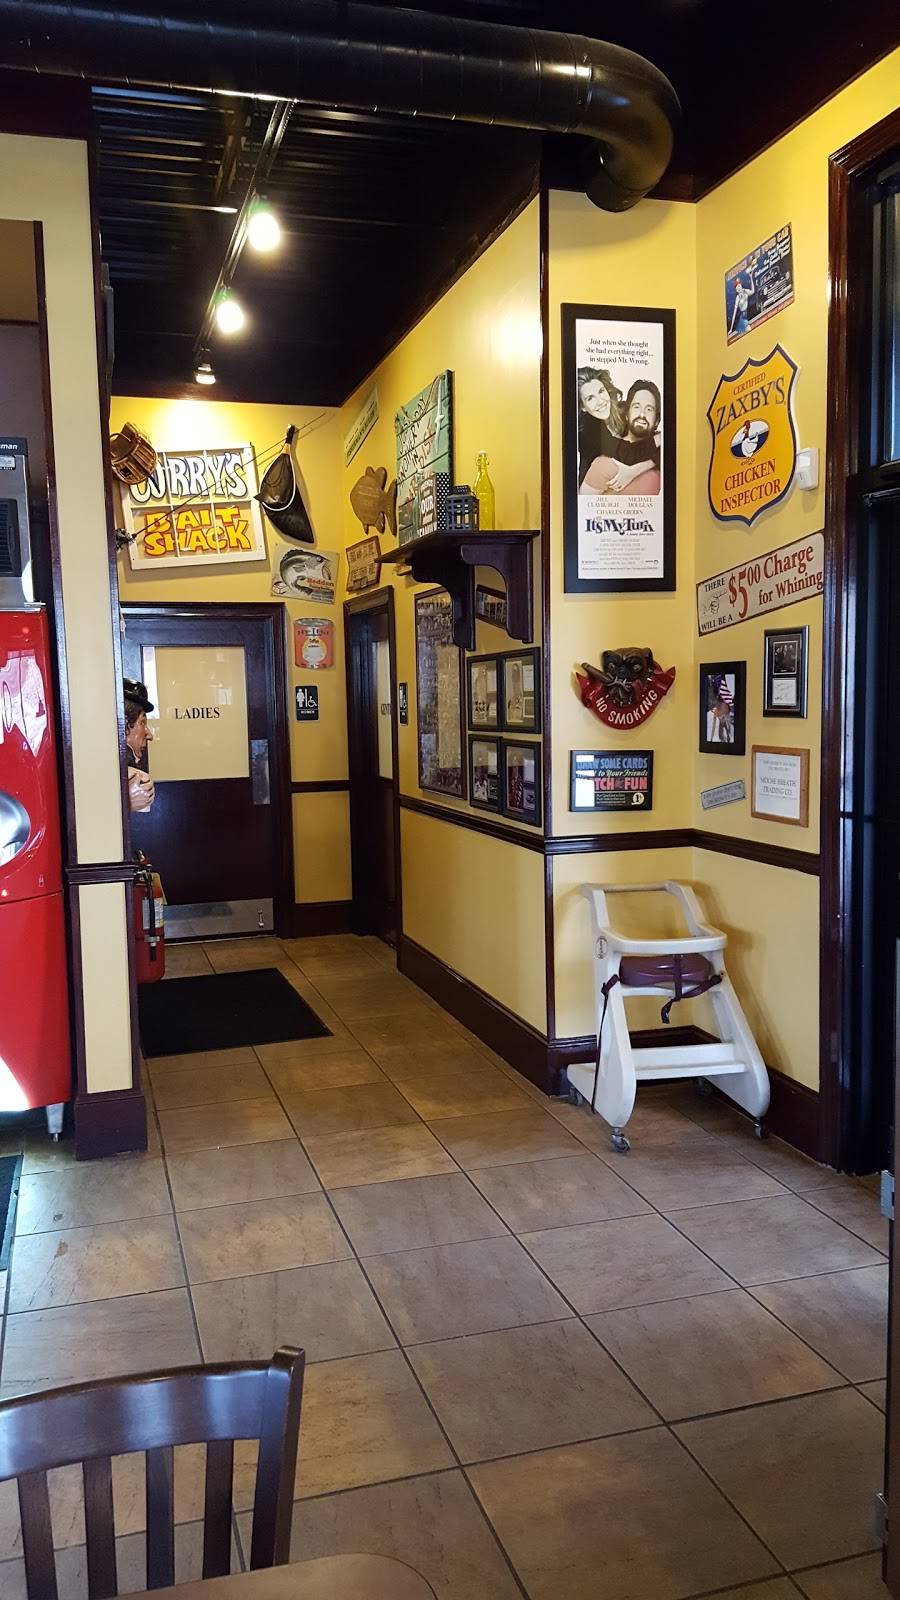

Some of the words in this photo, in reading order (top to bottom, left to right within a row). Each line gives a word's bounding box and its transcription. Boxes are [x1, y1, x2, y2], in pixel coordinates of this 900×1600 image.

[596, 357, 617, 365] stepped
[629, 358, 650, 366] Wrong.
[607, 349, 636, 357] everything
[733, 372, 766, 397] CERTIFIED
[716, 375, 786, 437] ZAXBY'S
[724, 458, 776, 492] CHICKEN
[720, 478, 782, 513] INSPECTOR
[145, 506, 240, 534] BAIT
[145, 520, 251, 556] SHACK
[763, 546, 815, 579] Charge
[704, 578, 726, 593] THERE
[759, 589, 773, 606] for
[775, 571, 824, 600] Whining
[701, 619, 717, 632] WILL
[717, 616, 727, 627] BE
[727, 613, 734, 624] A
[174, 706, 220, 720] LADIES
[594, 695, 608, 714] NO
[608, 689, 658, 725] SMOKING
[600, 758, 621, 770] SOME
[622, 758, 648, 769] CARDS
[606, 769, 623, 779] Your
[623, 769, 648, 777] Friends
[624, 778, 648, 790] FUN
